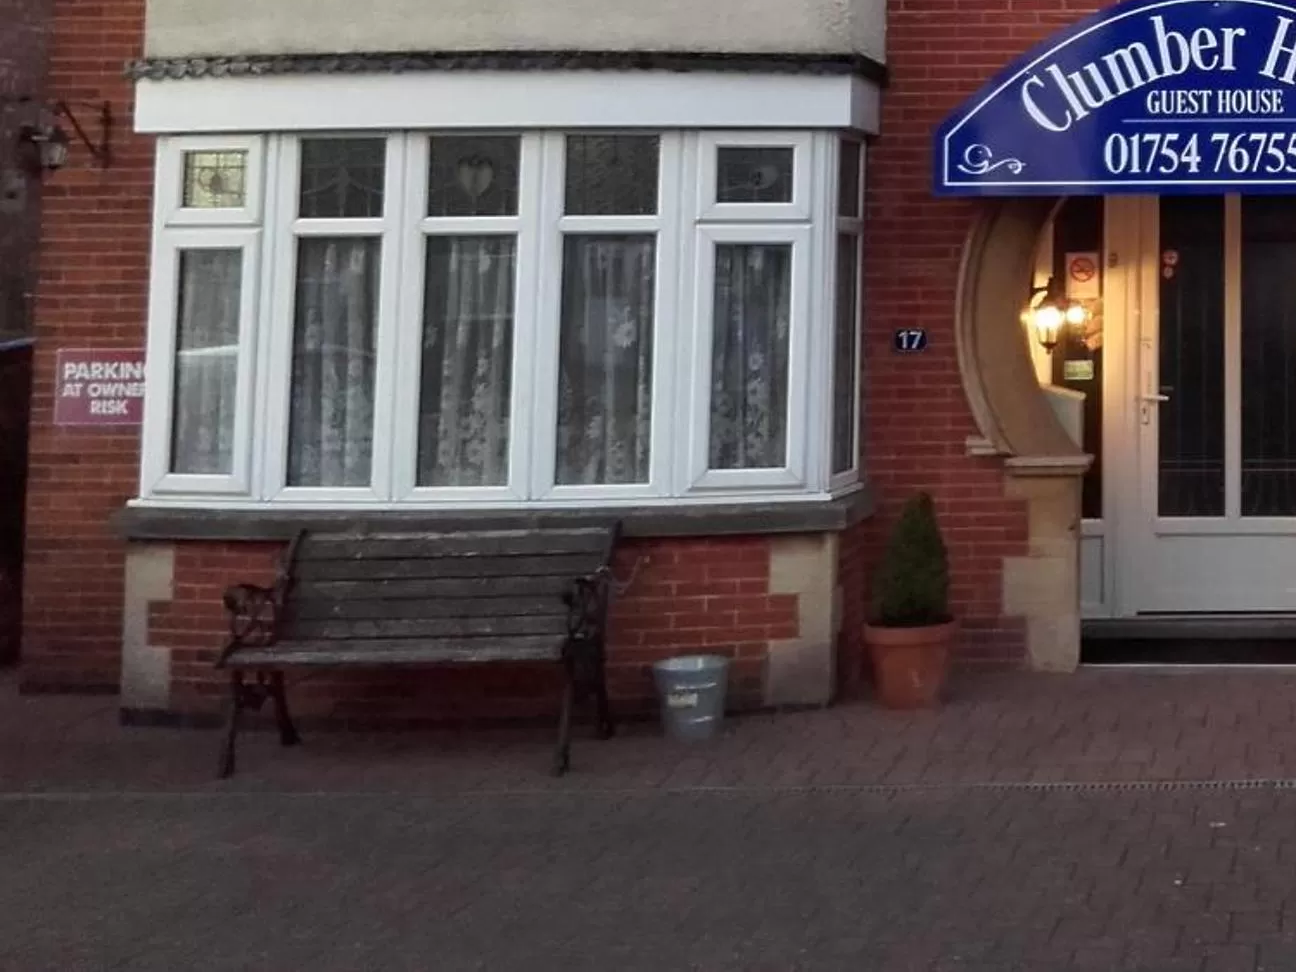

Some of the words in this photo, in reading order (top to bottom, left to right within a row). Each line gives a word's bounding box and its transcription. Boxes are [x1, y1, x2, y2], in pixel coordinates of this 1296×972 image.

[1022, 15, 1246, 132] Clumber
[1146, 89, 1212, 114] GUEST
[1217, 89, 1284, 114] HOUSE
[1104, 132, 1201, 174] 01754
[898, 330, 922, 349] 17
[63, 361, 146, 380] PARKIN
[61, 382, 83, 398] AT
[90, 399, 129, 415] RISK
